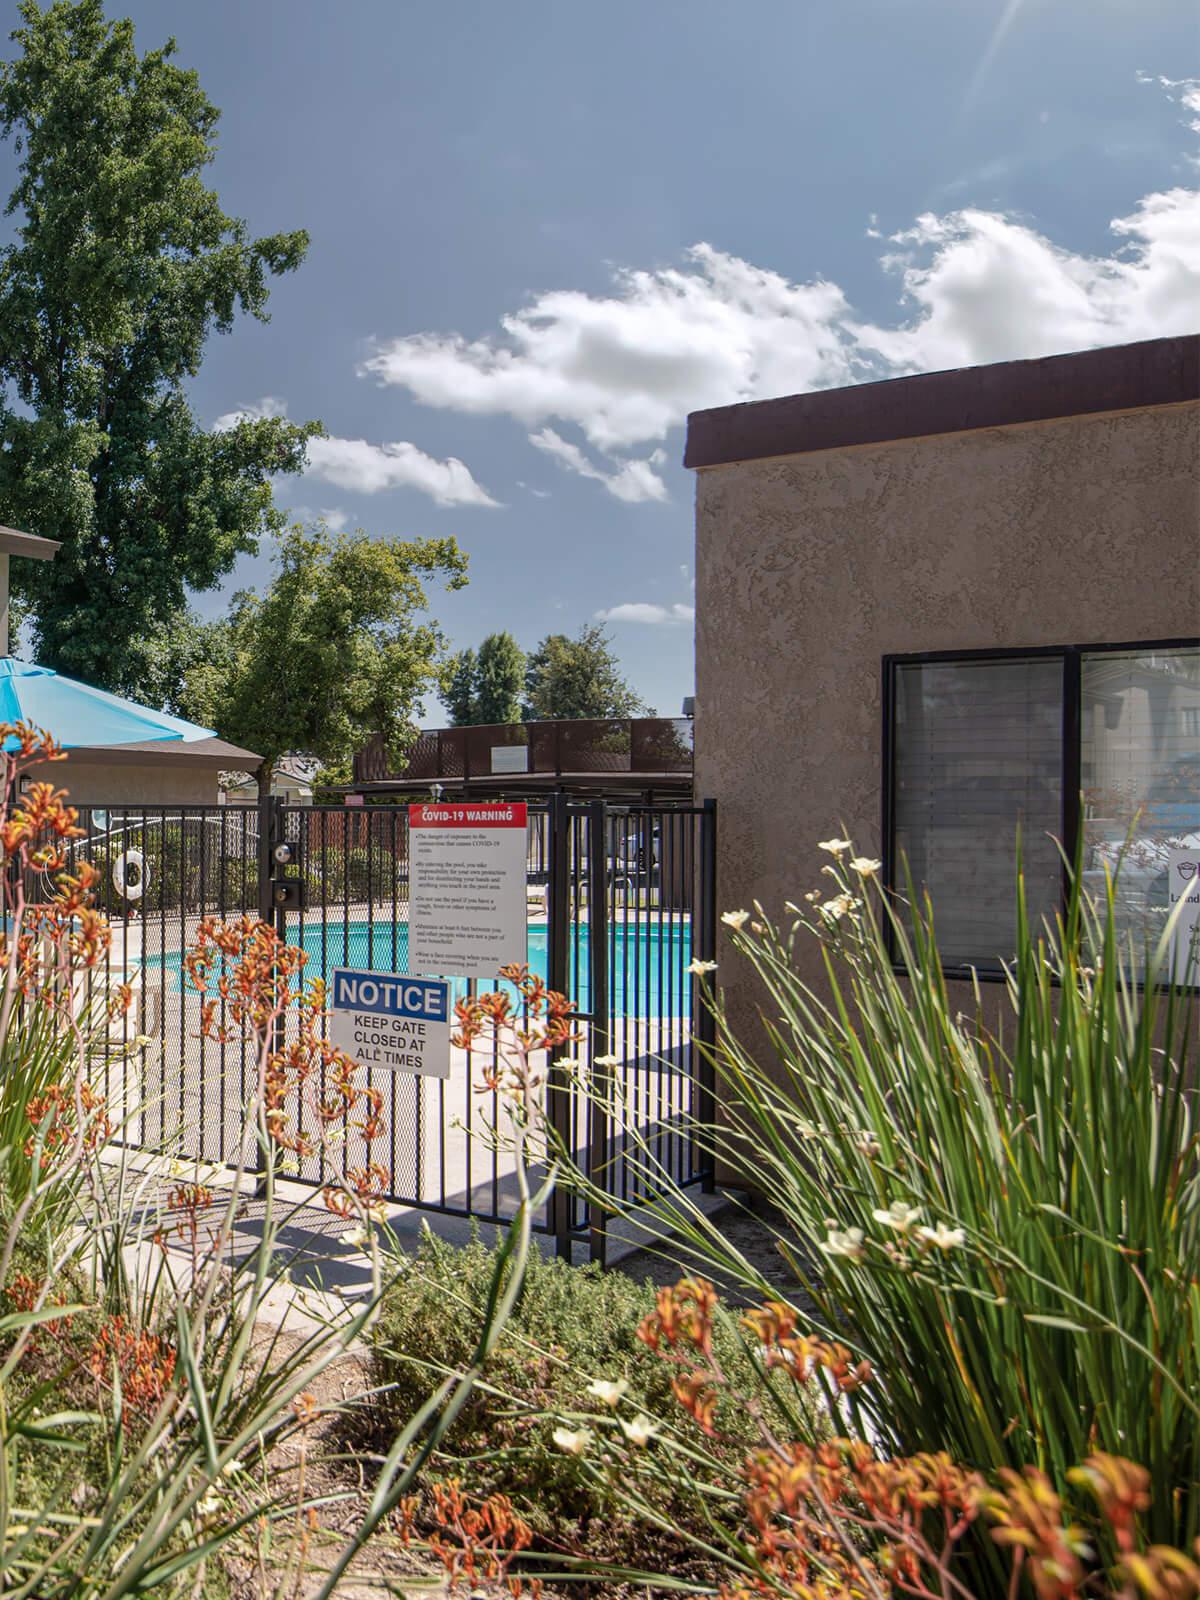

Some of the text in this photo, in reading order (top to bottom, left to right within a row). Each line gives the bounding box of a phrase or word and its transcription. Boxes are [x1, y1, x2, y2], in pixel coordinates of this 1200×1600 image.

[422, 810, 513, 821] COVID-19 WARNING
[340, 978, 442, 1014] NOTICE
[354, 1015, 426, 1036] KEEP GATE
[354, 1031, 426, 1052] CLOSED AT
[356, 1048, 422, 1068] ALL TIMES
